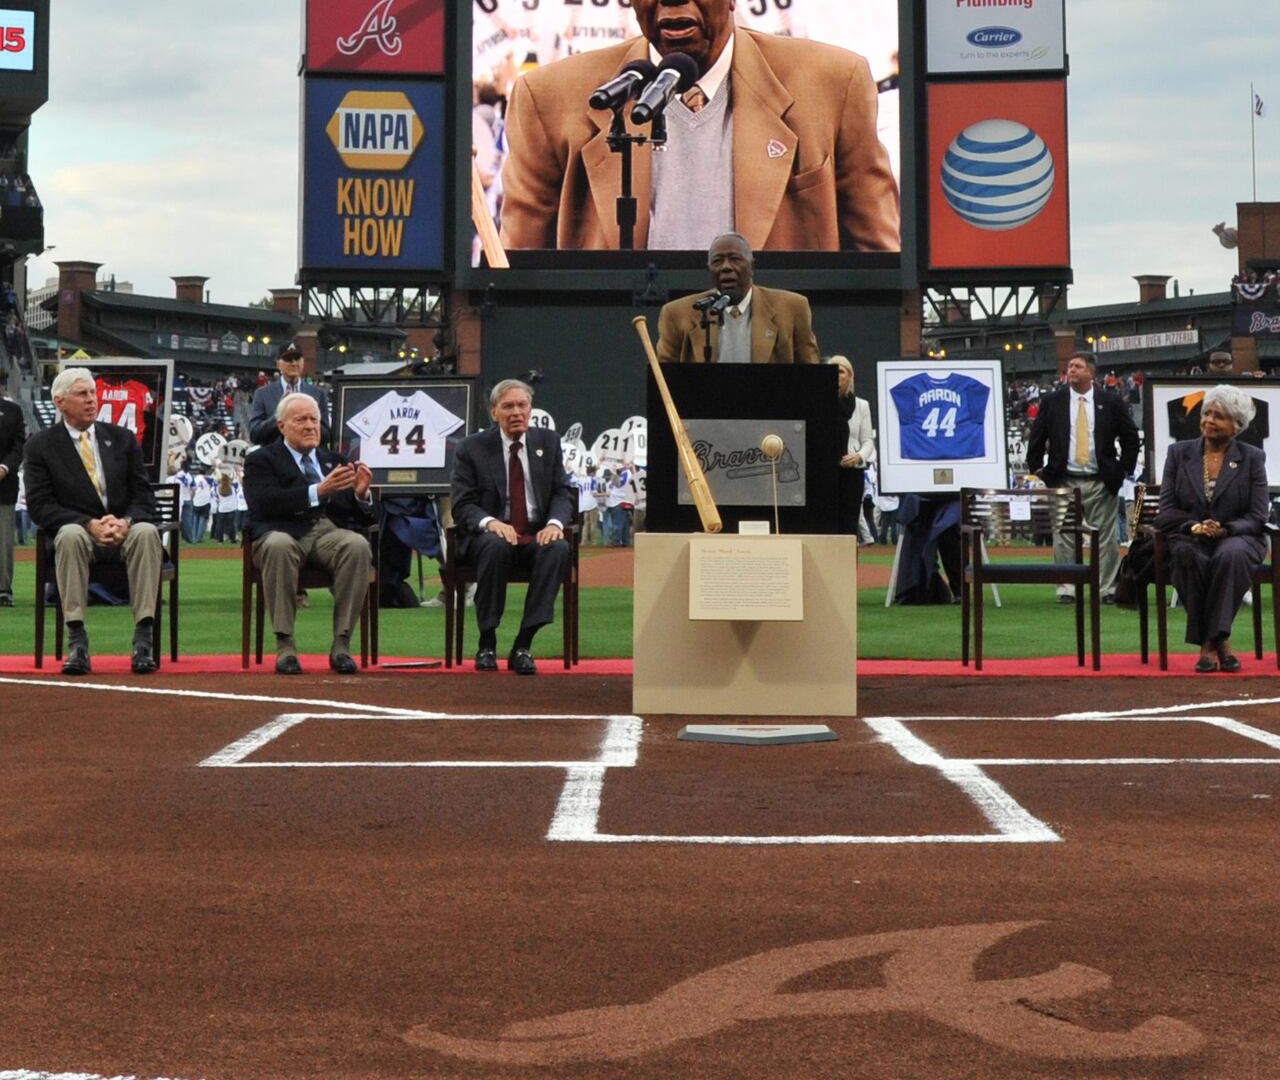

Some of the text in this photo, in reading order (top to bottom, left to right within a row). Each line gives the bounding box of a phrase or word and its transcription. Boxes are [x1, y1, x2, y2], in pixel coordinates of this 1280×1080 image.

[974, 31, 1015, 42] Carrier
[344, 113, 409, 150] NAPA
[337, 177, 414, 217] KNOW
[343, 217, 404, 257] HOW
[101, 390, 128, 400] AARON
[919, 388, 961, 407] AARON
[97, 404, 138, 434] 44
[390, 408, 421, 420] AARON
[921, 407, 957, 437] 44
[197, 434, 221, 457] 278
[380, 424, 426, 454] 44
[601, 435, 629, 452] 211
[223, 445, 246, 457] 114
